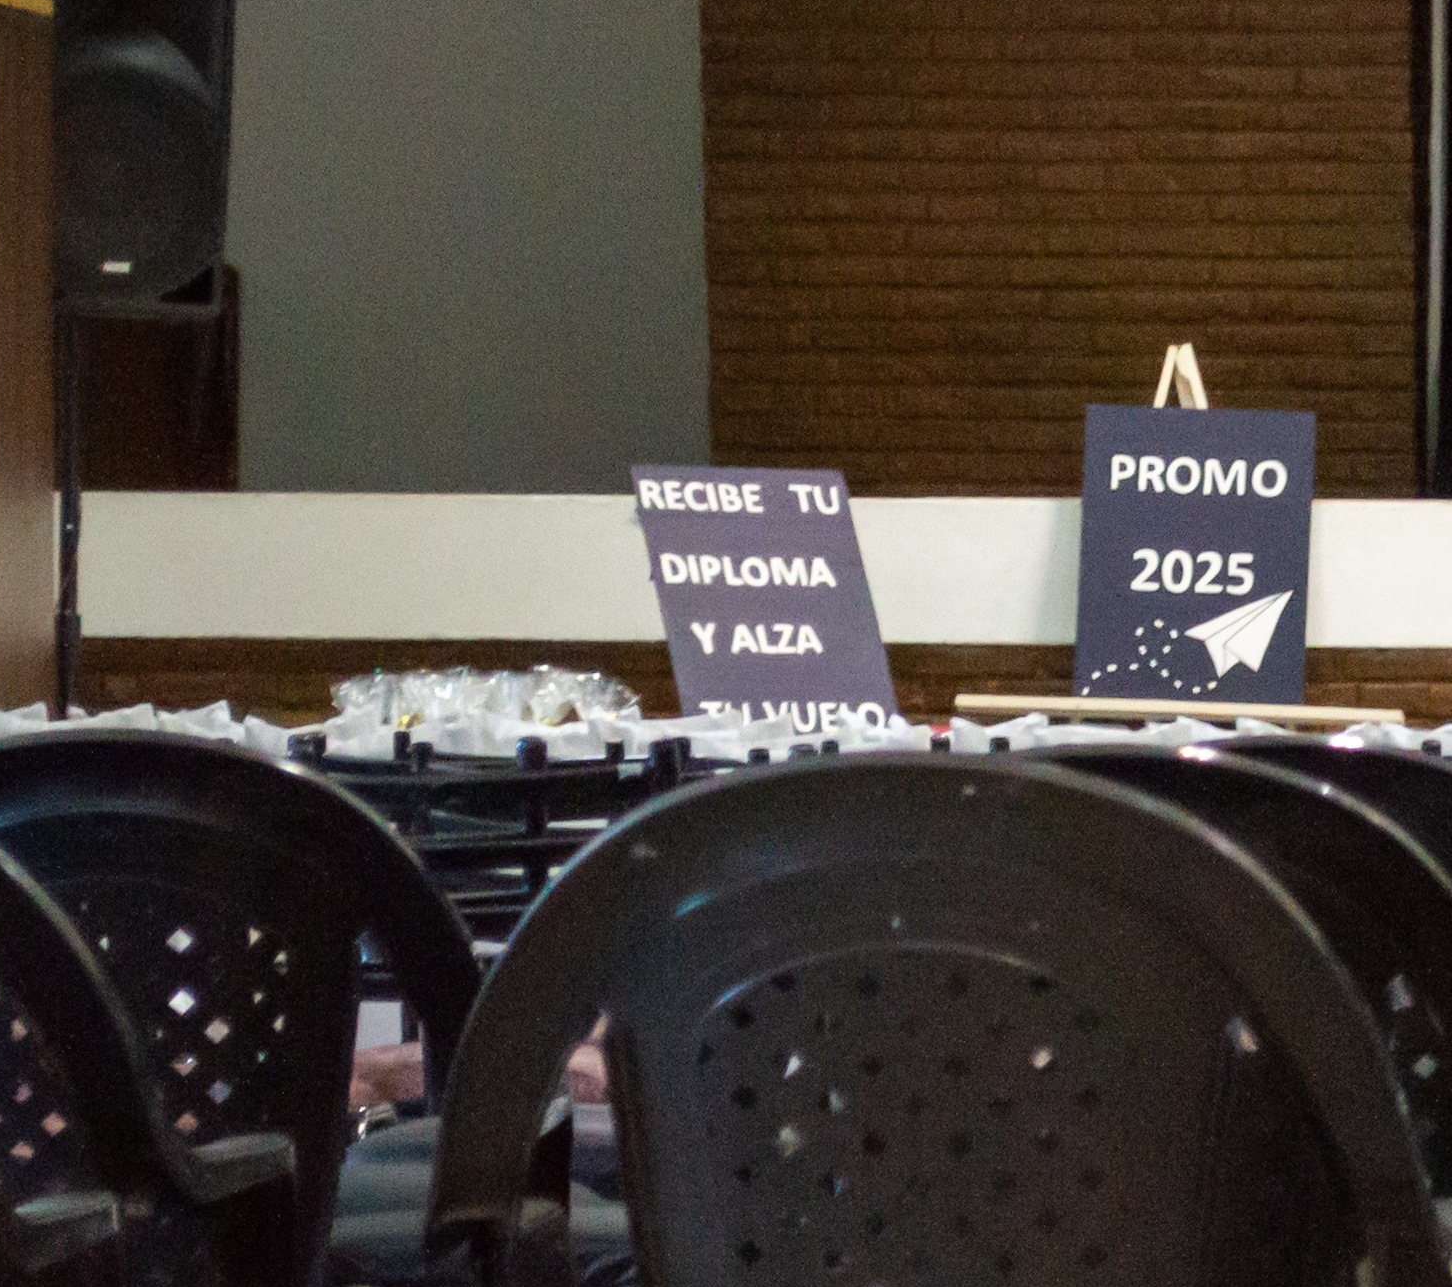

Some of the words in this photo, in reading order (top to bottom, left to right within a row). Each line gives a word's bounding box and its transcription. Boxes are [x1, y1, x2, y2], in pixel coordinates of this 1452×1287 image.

[1110, 453, 1288, 498] PROMO
[638, 478, 765, 514] RECIBE
[787, 483, 841, 516] TU
[658, 551, 838, 589] DIPLOMA
[1129, 547, 1256, 596] 2025
[689, 621, 717, 656] Y
[730, 622, 825, 656] ALZA
[761, 700, 887, 735] VUEO
